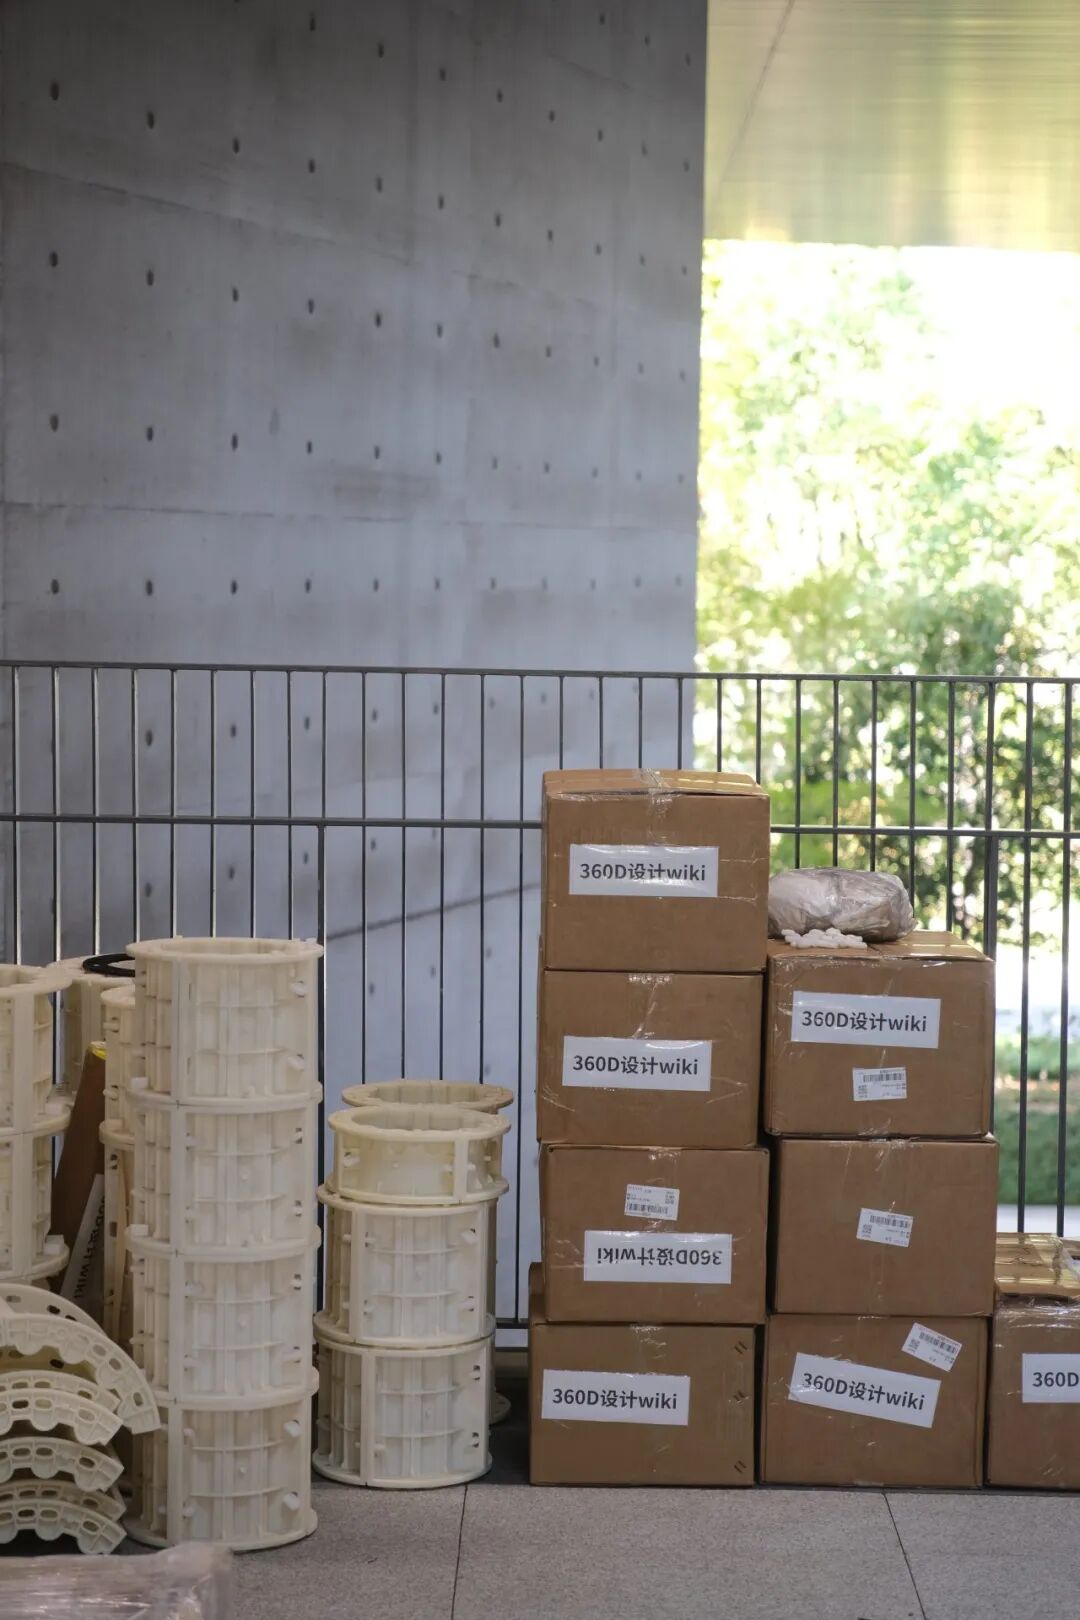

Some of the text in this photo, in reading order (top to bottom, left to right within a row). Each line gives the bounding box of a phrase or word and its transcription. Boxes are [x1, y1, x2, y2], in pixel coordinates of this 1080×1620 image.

[579, 862, 706, 881] 360D设计wiki
[801, 1010, 927, 1032] 360D设计wiki
[572, 1055, 699, 1076] 360D设计wiki
[597, 1247, 723, 1266] 360D设计wiki
[1032, 1371, 1079, 1388] 360D
[552, 1388, 677, 1409] 360D设计wiki
[802, 1372, 925, 1411] 360D设计wiki
